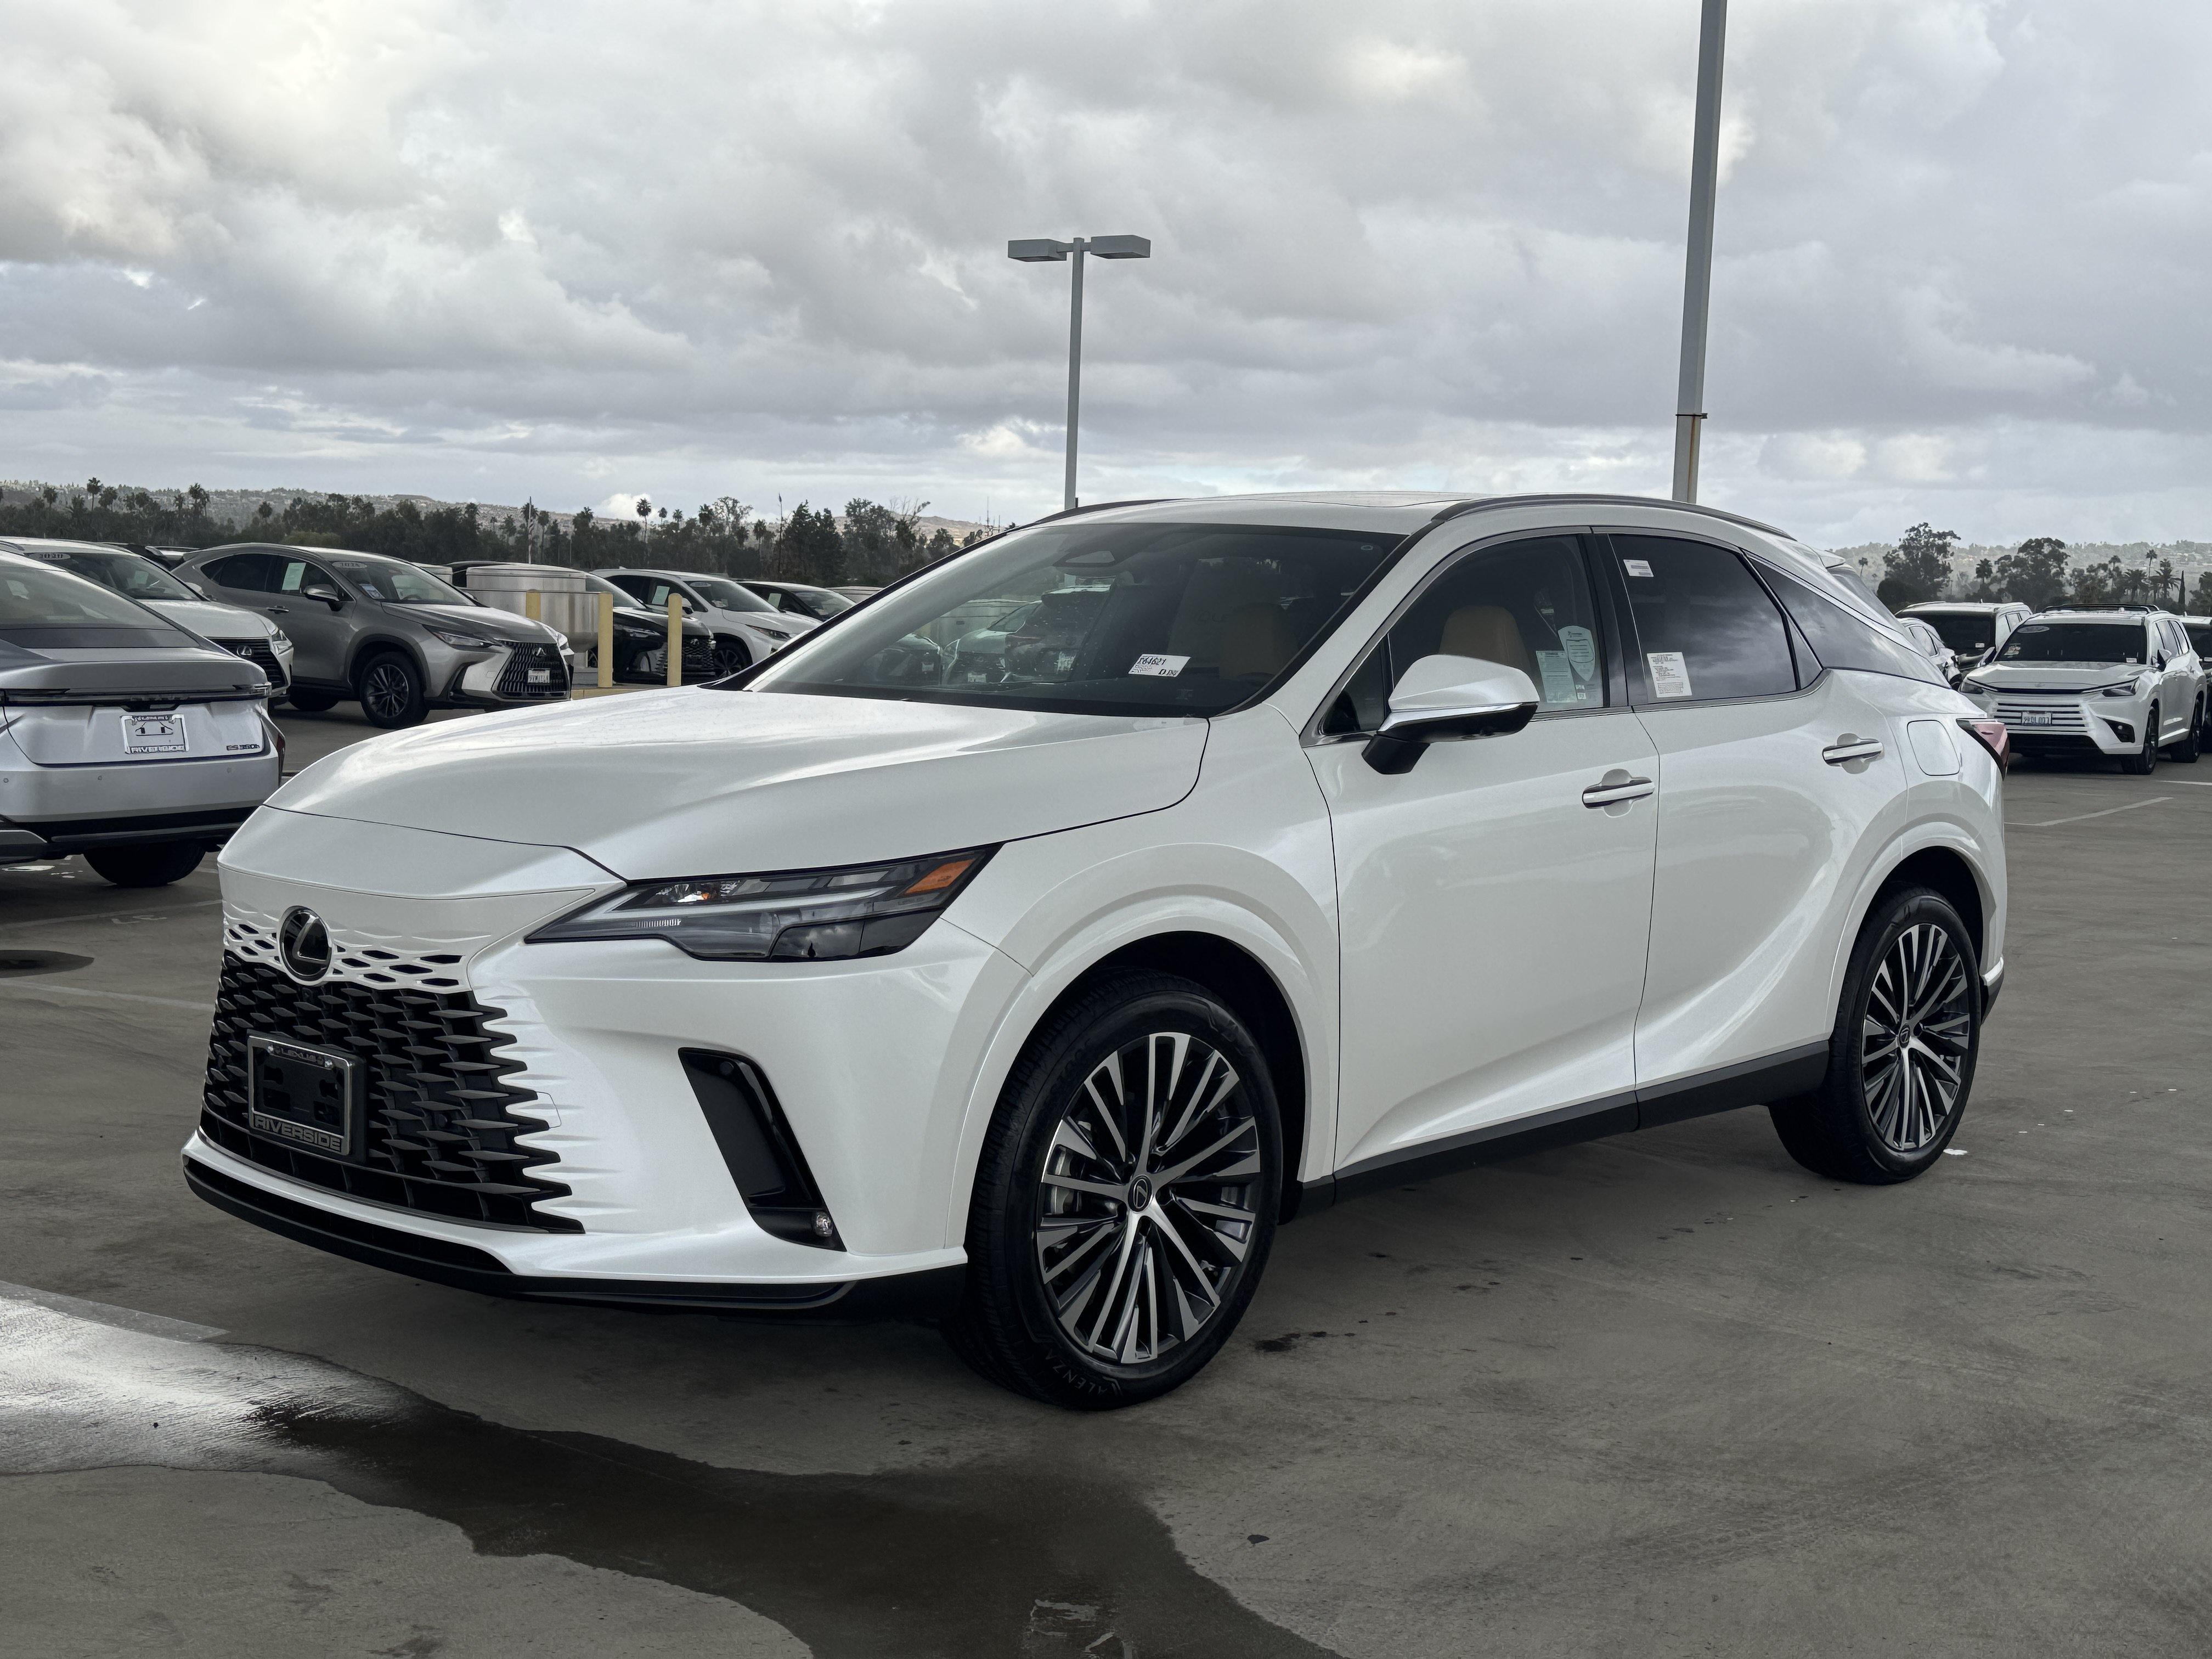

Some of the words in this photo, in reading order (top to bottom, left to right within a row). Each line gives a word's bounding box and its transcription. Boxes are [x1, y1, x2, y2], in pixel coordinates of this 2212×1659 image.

[281, 1048, 316, 1063] LEXUS
[255, 1116, 341, 1152] RIVERSIDE
[1045, 1347, 1109, 1397] ALENZA
